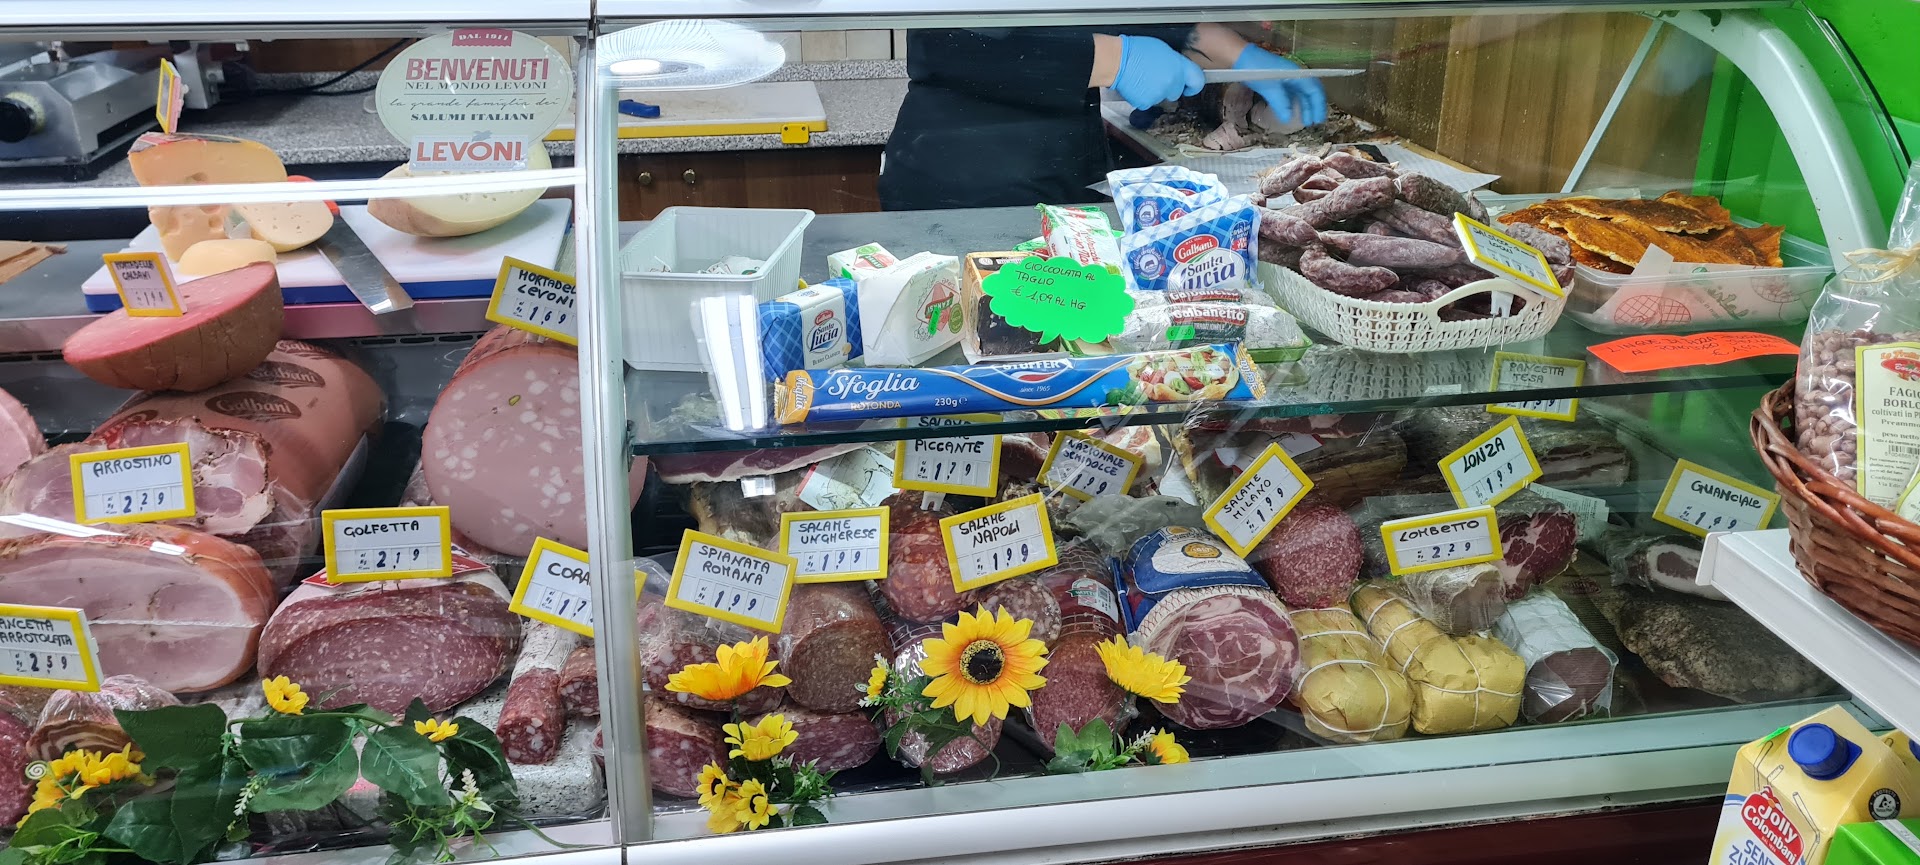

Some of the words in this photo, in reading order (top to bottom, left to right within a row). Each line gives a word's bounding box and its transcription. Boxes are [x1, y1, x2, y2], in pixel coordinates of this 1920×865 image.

[459, 33, 481, 41] DAL
[405, 58, 549, 81] BENVENUTI
[405, 82, 433, 90] NEL
[438, 81, 490, 90] MONDO
[495, 81, 546, 90] LEVONI
[389, 98, 406, 107] la
[410, 98, 462, 110] grande
[466, 98, 530, 111] famiglia
[536, 98, 560, 106] dei
[411, 113, 466, 121] SALUMI
[471, 113, 535, 121] ITALIANI
[416, 141, 522, 162] LEVONI
[1178, 238, 1214, 260] Galbani
[1024, 261, 1082, 279] CIOCCOLATA
[1085, 272, 1095, 281] AL
[1187, 255, 1223, 277] Santa
[1015, 270, 1055, 286] TAGLIO
[1026, 291, 1053, 305] 1,09
[1055, 298, 1066, 306] AL
[1070, 299, 1087, 310] HG
[529, 306, 566, 325] 1,69
[1173, 307, 1242, 321] Galbanetto
[1509, 362, 1565, 376] PANCETTA
[1513, 373, 1544, 383] TESA
[793, 375, 808, 410] Sfoglia
[827, 372, 920, 400] Sfoglia
[216, 398, 292, 414] Galbani
[850, 401, 901, 411] ROTONDA
[934, 397, 958, 408] 230g
[1872, 408, 1903, 417] coltivati
[914, 439, 985, 454] PICCANTE
[1068, 439, 1125, 468] NAZIONALE
[1463, 437, 1506, 473] LONZA
[92, 454, 172, 477] ARROSTINO
[933, 462, 971, 480] 1,79
[123, 492, 164, 514] 2,29
[1223, 473, 1262, 514] SALAME
[1233, 479, 1272, 519] MILANO
[798, 519, 851, 533] SALAME
[959, 512, 1007, 535] SALAME
[801, 528, 877, 544] UNGHERESE
[973, 520, 1020, 548] NAPOLI
[376, 549, 420, 569] 2,19
[699, 545, 770, 575] SPIANATA
[993, 543, 1029, 571] 1,99
[1431, 542, 1471, 559] 2,29
[822, 551, 861, 571] 1,99
[703, 560, 763, 586] ROMANA
[714, 590, 757, 612] 1,99
[29, 652, 68, 674] 2,59
[1757, 804, 1798, 844] Jolly
[1743, 805, 1798, 865] Colombani
